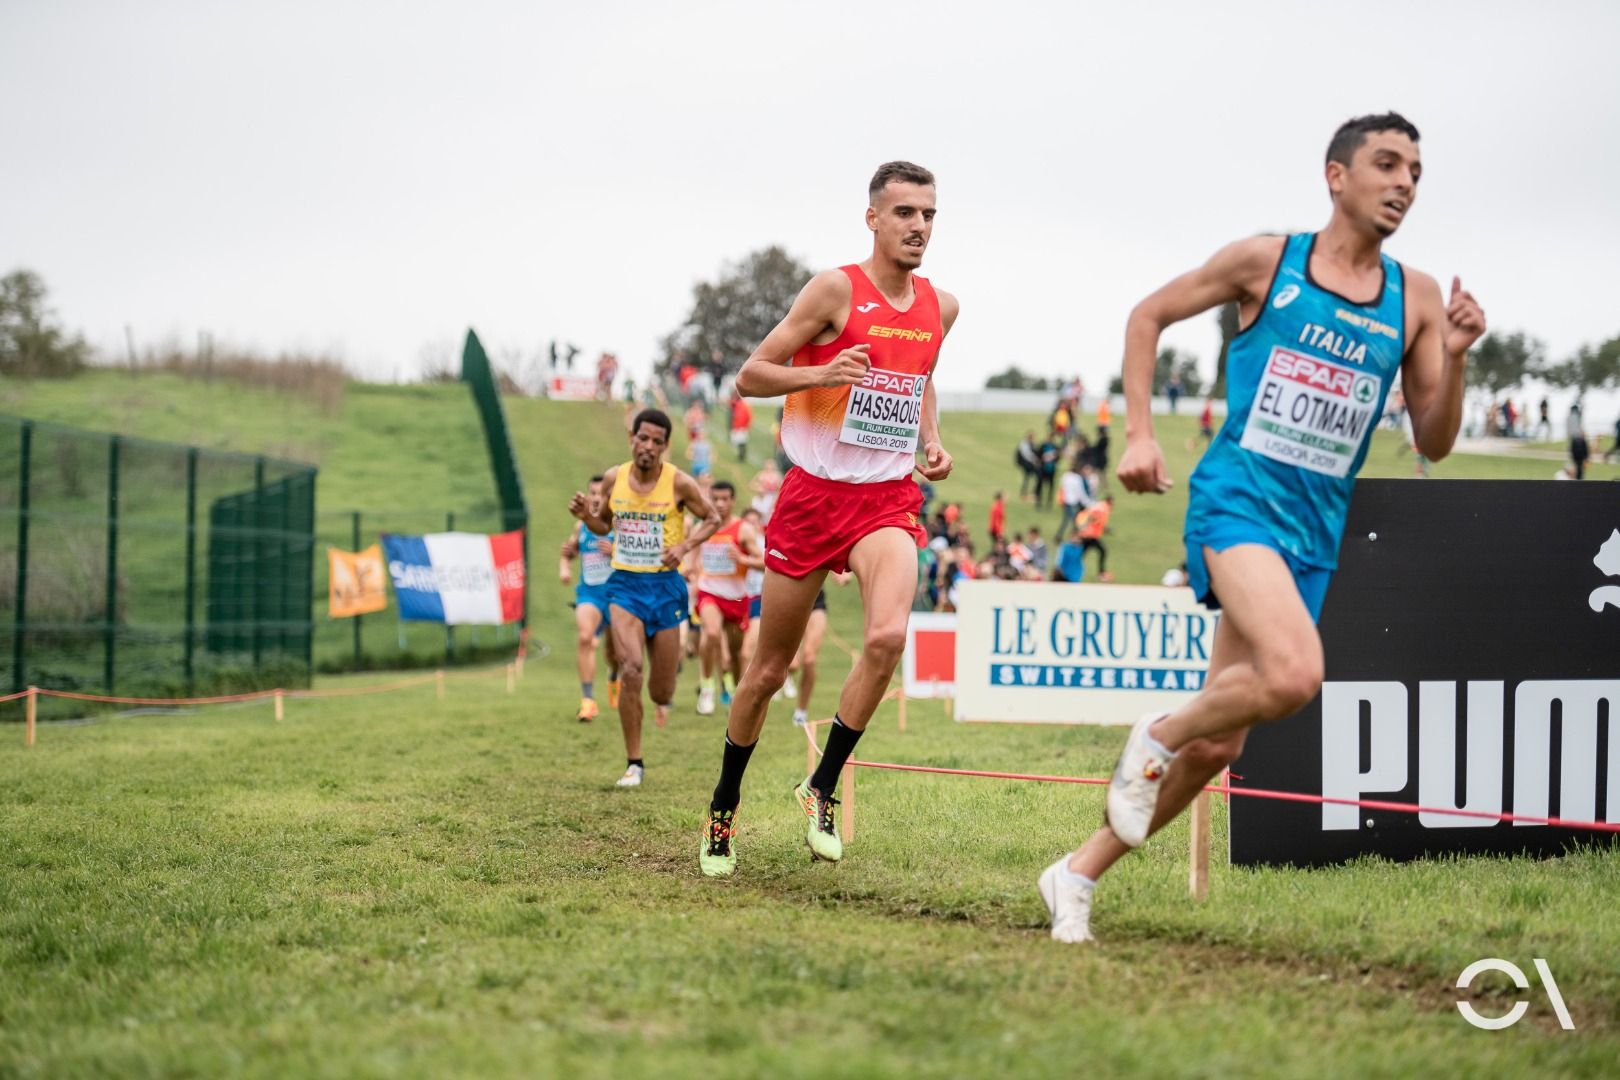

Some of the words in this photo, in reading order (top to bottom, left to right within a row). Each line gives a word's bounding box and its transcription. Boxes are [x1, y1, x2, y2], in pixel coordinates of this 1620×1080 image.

[867, 325, 933, 343] ESPAÑA
[1298, 323, 1368, 365] ITALIA
[862, 371, 914, 394] SPAR
[1271, 350, 1353, 395] SPAR
[850, 390, 920, 425] HASSAOUS
[1259, 381, 1283, 418] EL
[1291, 393, 1370, 441] OTMANI
[856, 433, 888, 447] LISBOA
[889, 438, 908, 449] 2019
[866, 423, 883, 433] RUN
[883, 425, 907, 436] CLEAN
[614, 510, 666, 523] SWEDEN
[618, 533, 660, 551] ABRAHA
[992, 607, 1036, 655] LE
[1050, 603, 1219, 661] GRUYÈR
[999, 667, 1201, 690] SWITZERLAN
